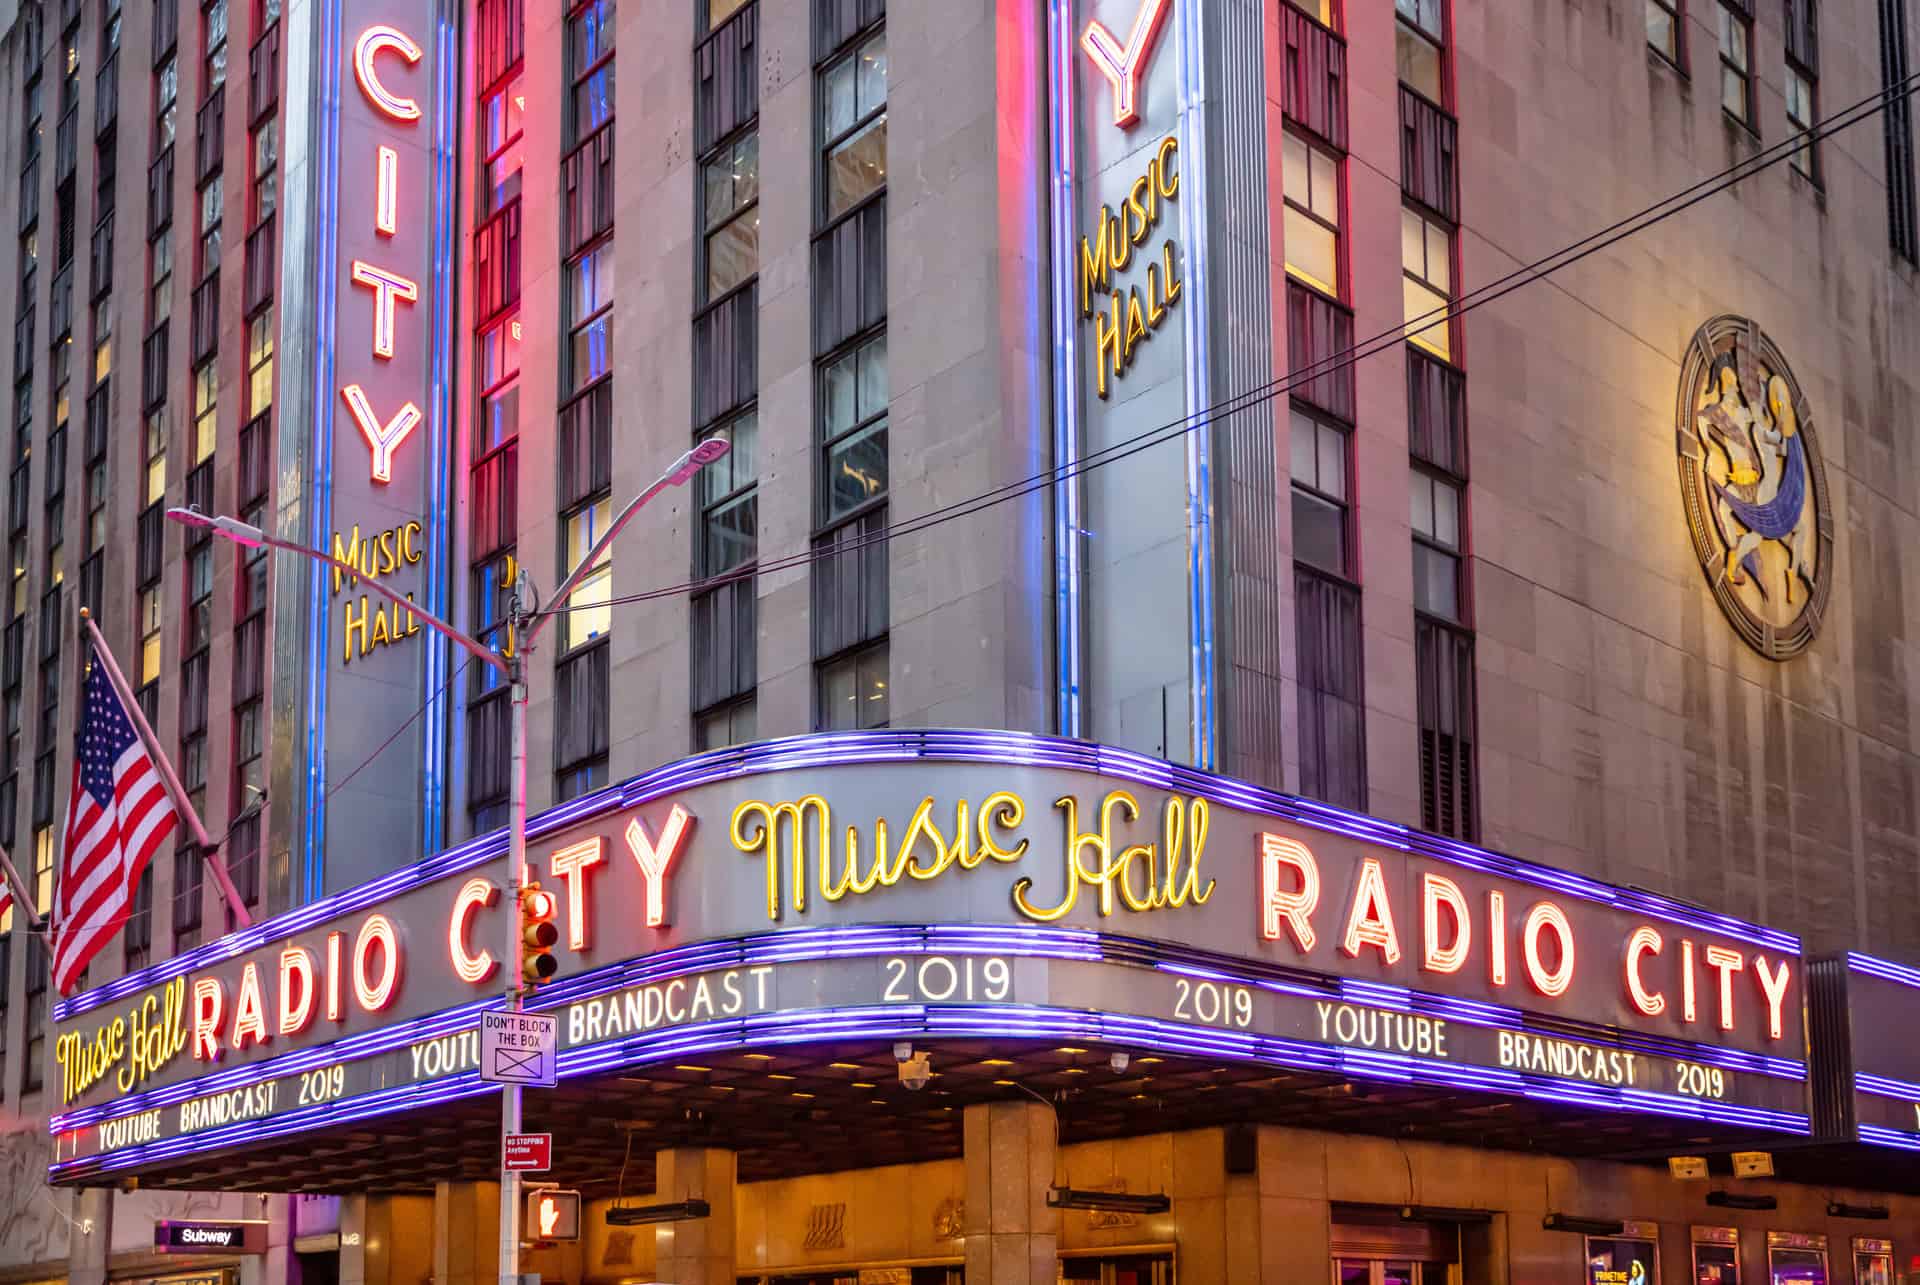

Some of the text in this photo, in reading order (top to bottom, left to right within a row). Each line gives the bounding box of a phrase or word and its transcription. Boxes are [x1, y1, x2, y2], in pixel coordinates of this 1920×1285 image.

[341, 25, 423, 484] CITY
[1079, 137, 1179, 319] MUSIC
[1096, 239, 1181, 399] HALL
[333, 521, 421, 595] MUSIC
[344, 592, 420, 663] HALL
[193, 803, 696, 1061] RADIO CTY
[1257, 832, 1790, 1040] RADIO CITY
[411, 956, 1010, 1078] YOUTU BRANDCAST 2019
[486, 1015, 552, 1033] DON'T BLOCK
[498, 1032, 541, 1048] THE BOX
[1175, 978, 1724, 1098] 2019 YOUTUBE BRANDCAST 2019
[99, 1065, 344, 1150] YOUTUBE BRANDCAST 2019
[182, 1229, 231, 1245] Subway
